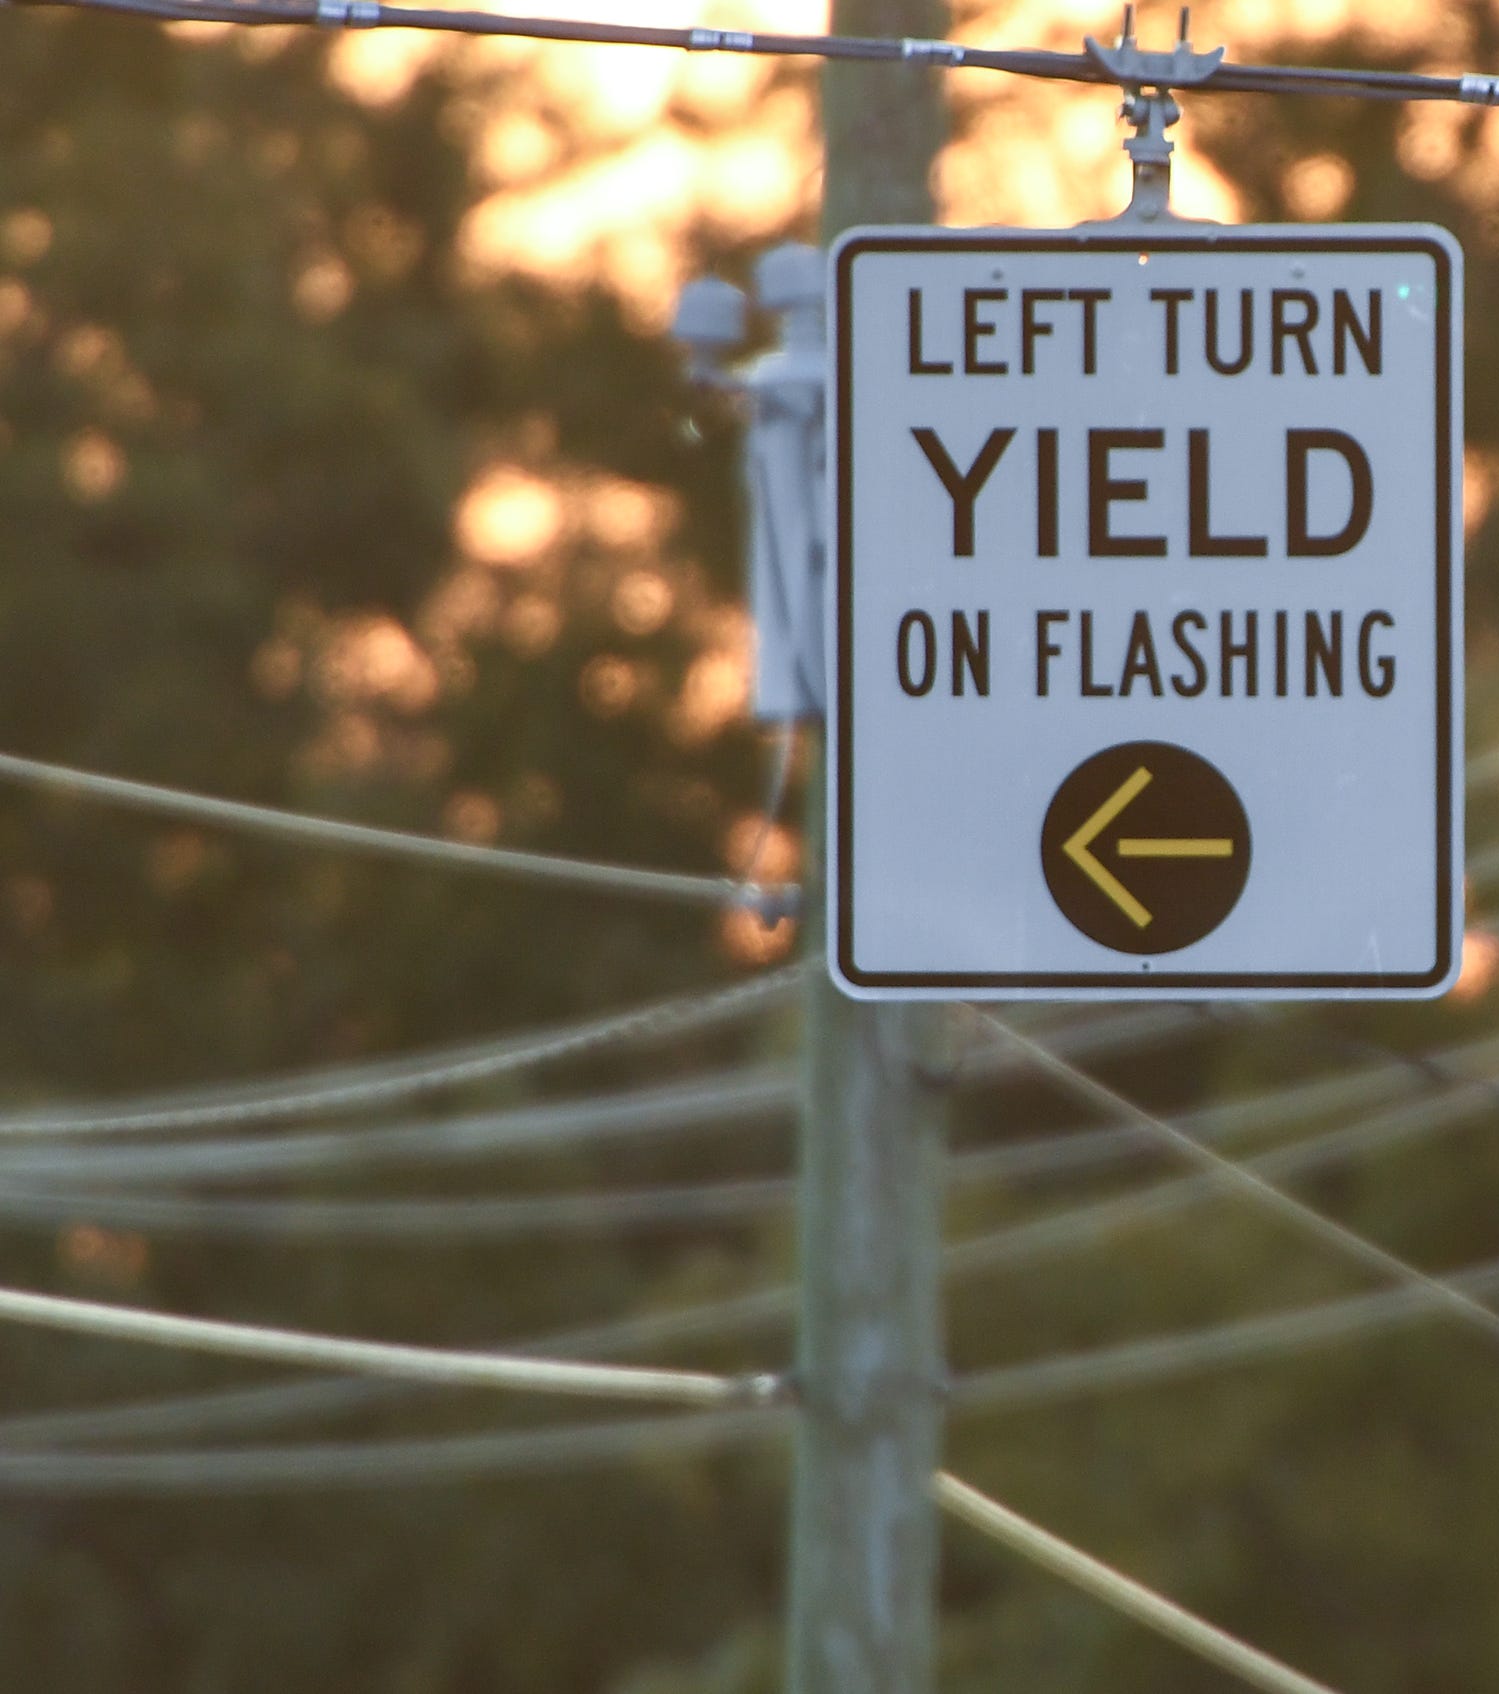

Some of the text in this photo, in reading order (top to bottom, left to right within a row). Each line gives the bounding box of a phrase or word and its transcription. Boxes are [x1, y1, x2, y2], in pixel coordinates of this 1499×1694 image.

[908, 287, 1382, 376] LEFT TURN
[910, 427, 1374, 558] YIELD
[896, 609, 1396, 698] ON FLASHING
